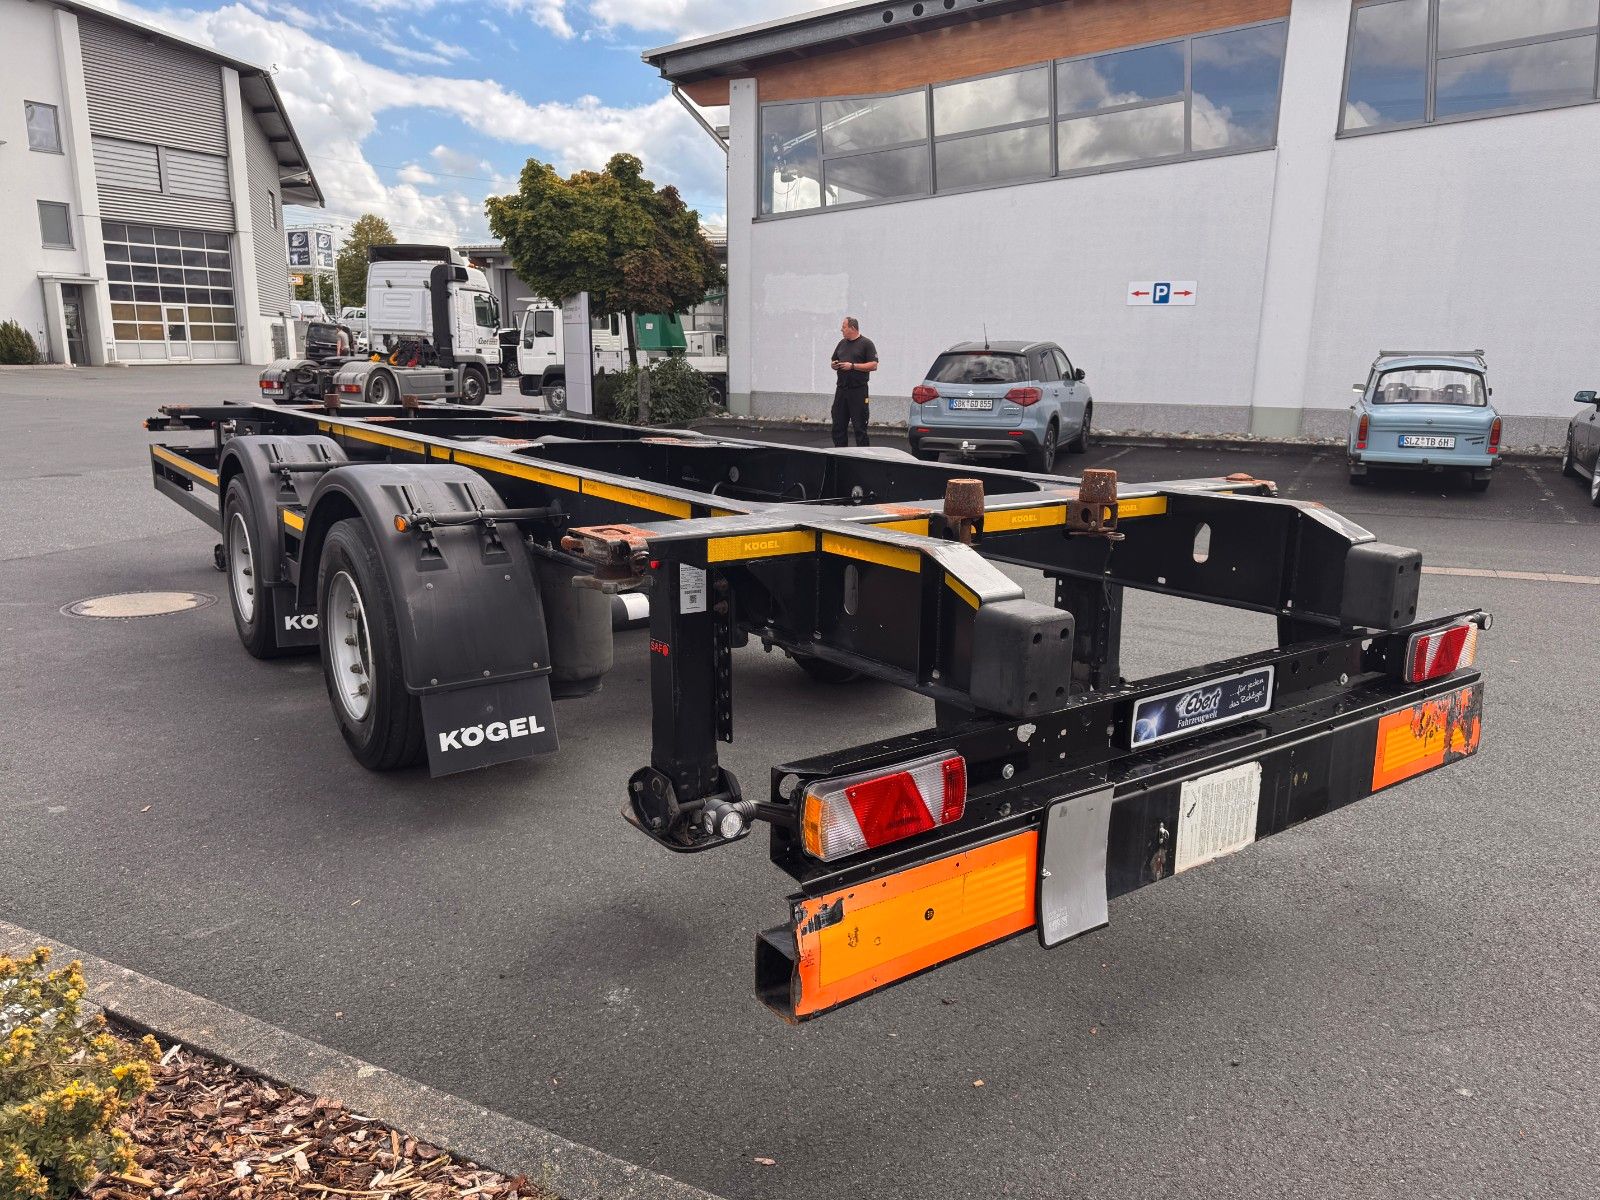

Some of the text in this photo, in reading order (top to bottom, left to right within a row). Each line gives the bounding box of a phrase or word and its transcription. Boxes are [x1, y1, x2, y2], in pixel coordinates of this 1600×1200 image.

[1155, 285, 1168, 301] P
[953, 399, 992, 408] SBK GD 855
[1404, 436, 1449, 447] SLZ TB 6H
[284, 613, 319, 630] KÖ
[1185, 690, 1220, 715] Ebert
[1229, 700, 1240, 709] das
[1177, 709, 1218, 728] Fahrzeugwelt
[438, 715, 546, 752] KÖGEL
